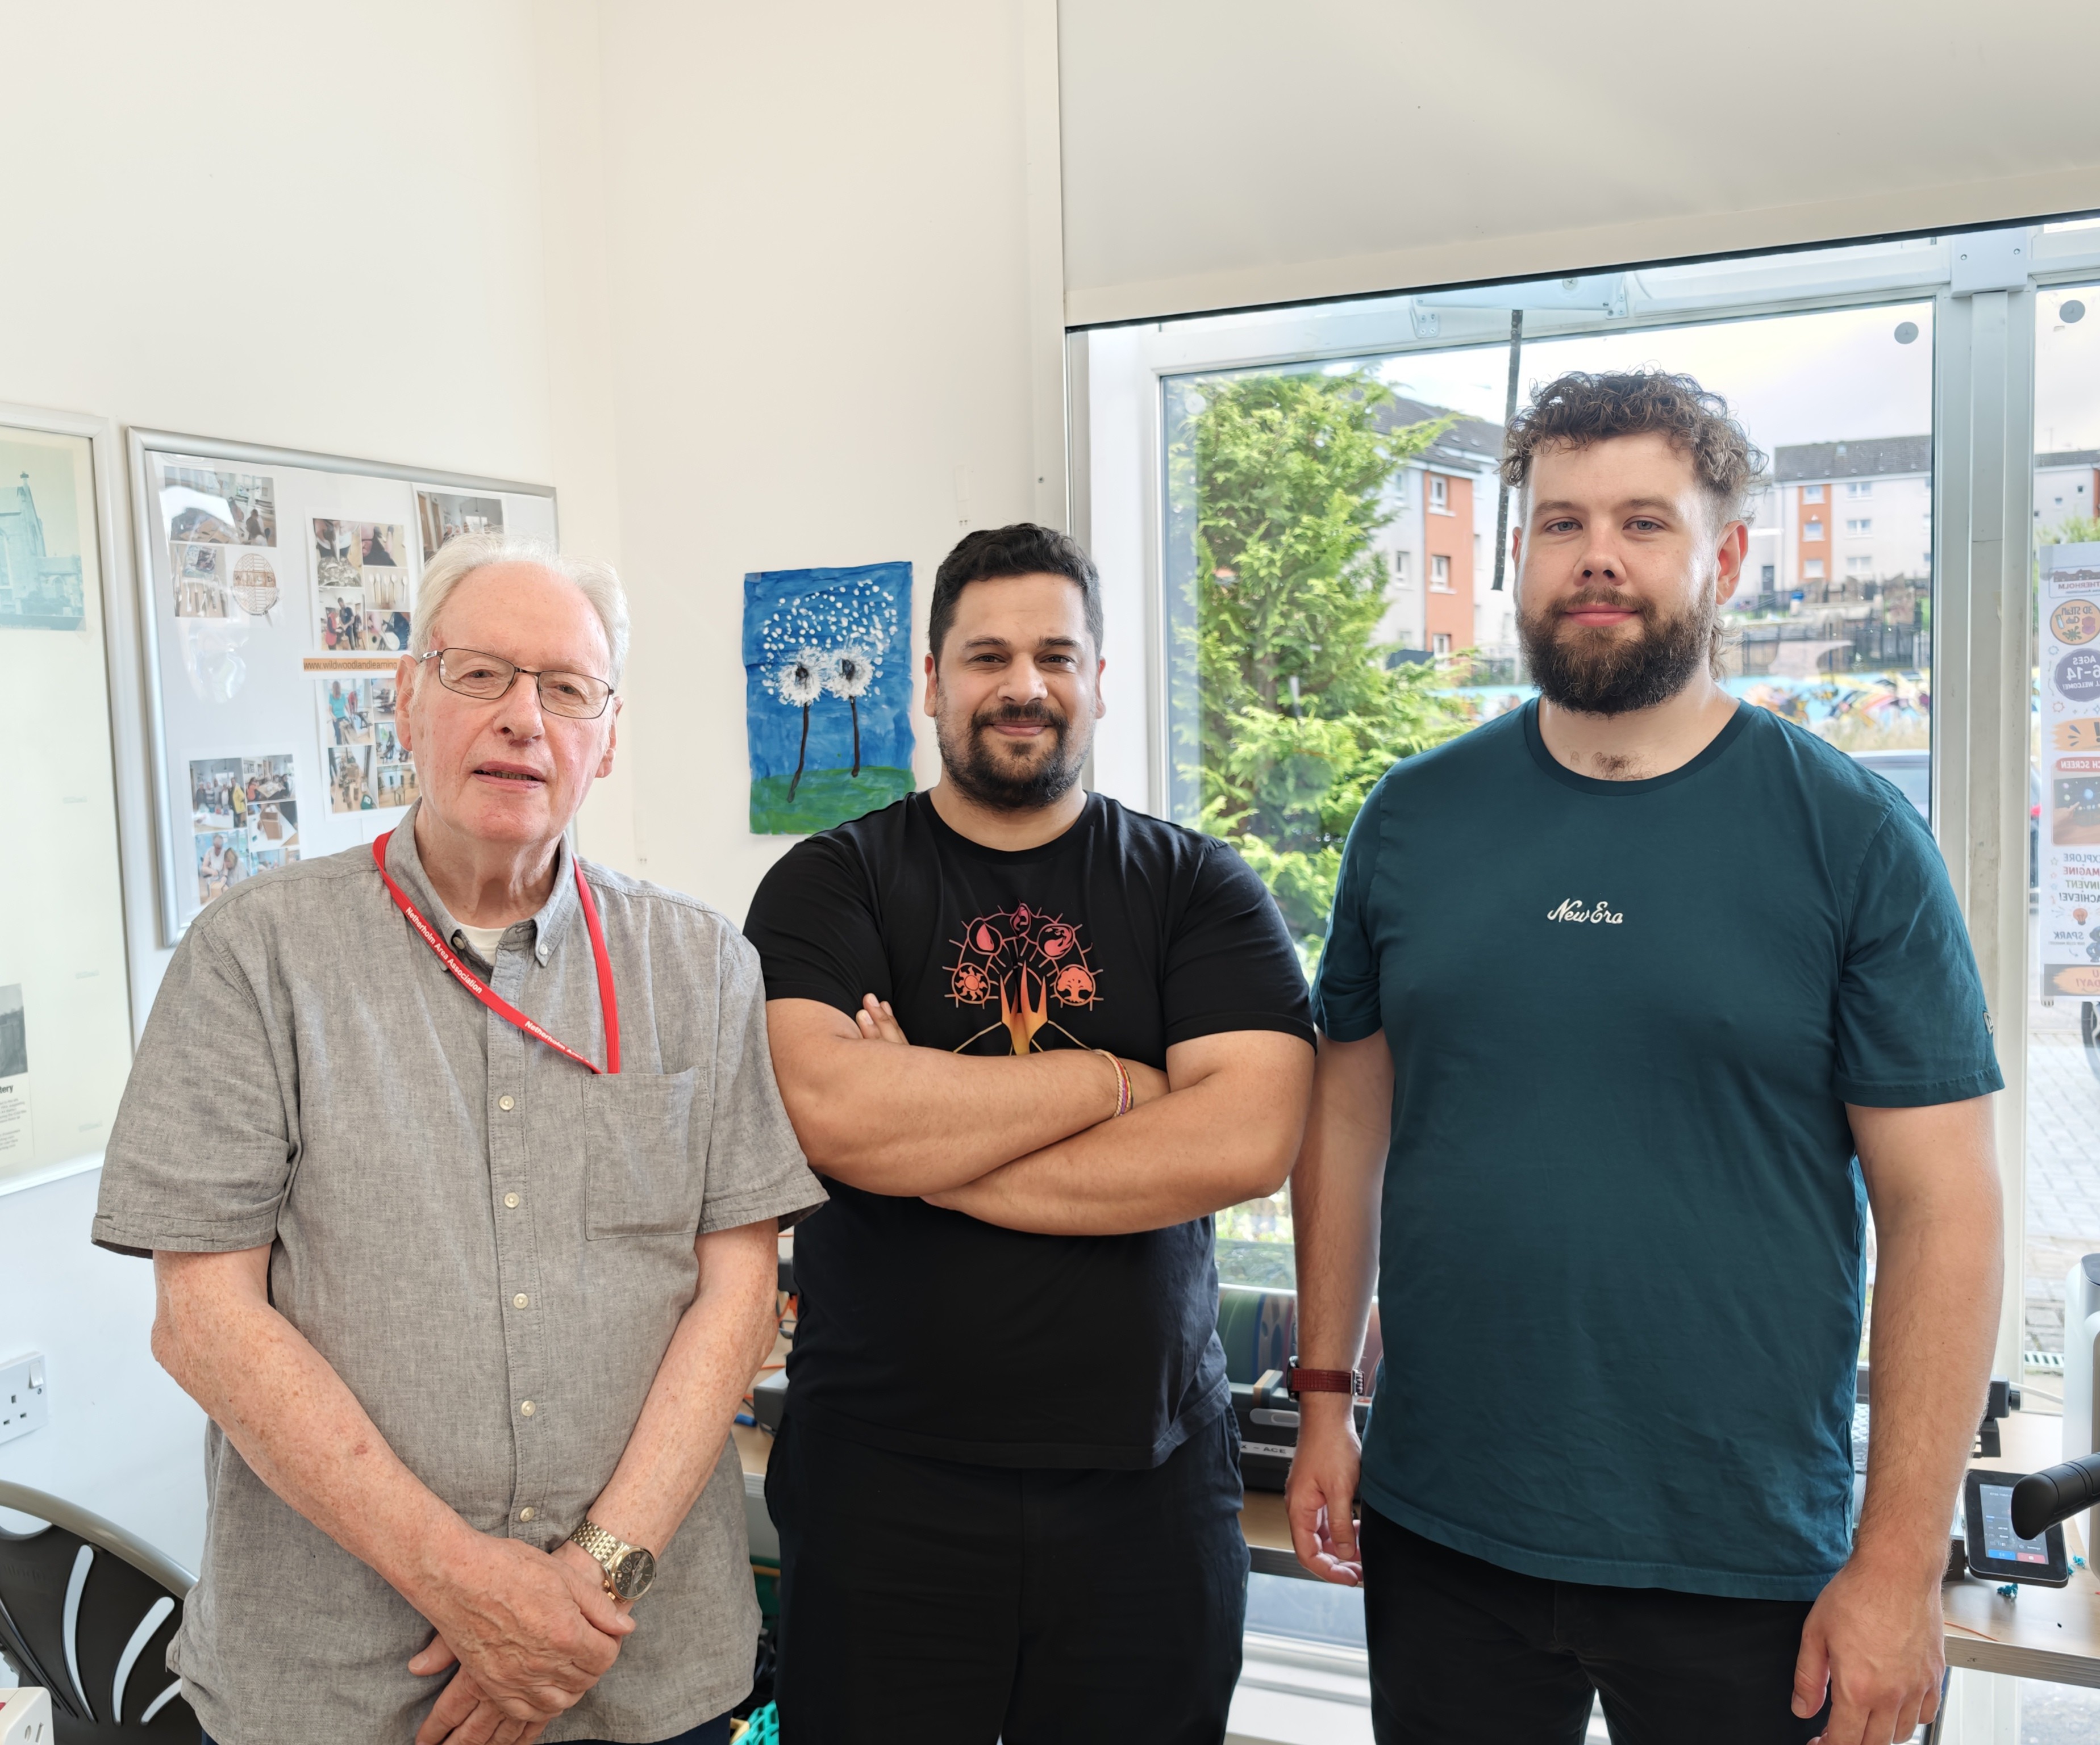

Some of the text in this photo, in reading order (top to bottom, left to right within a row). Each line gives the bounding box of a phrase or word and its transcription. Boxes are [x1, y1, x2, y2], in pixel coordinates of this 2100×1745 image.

[406, 907, 482, 994] Netherholm Area Association
[524, 1020, 566, 1050] Netherholm
